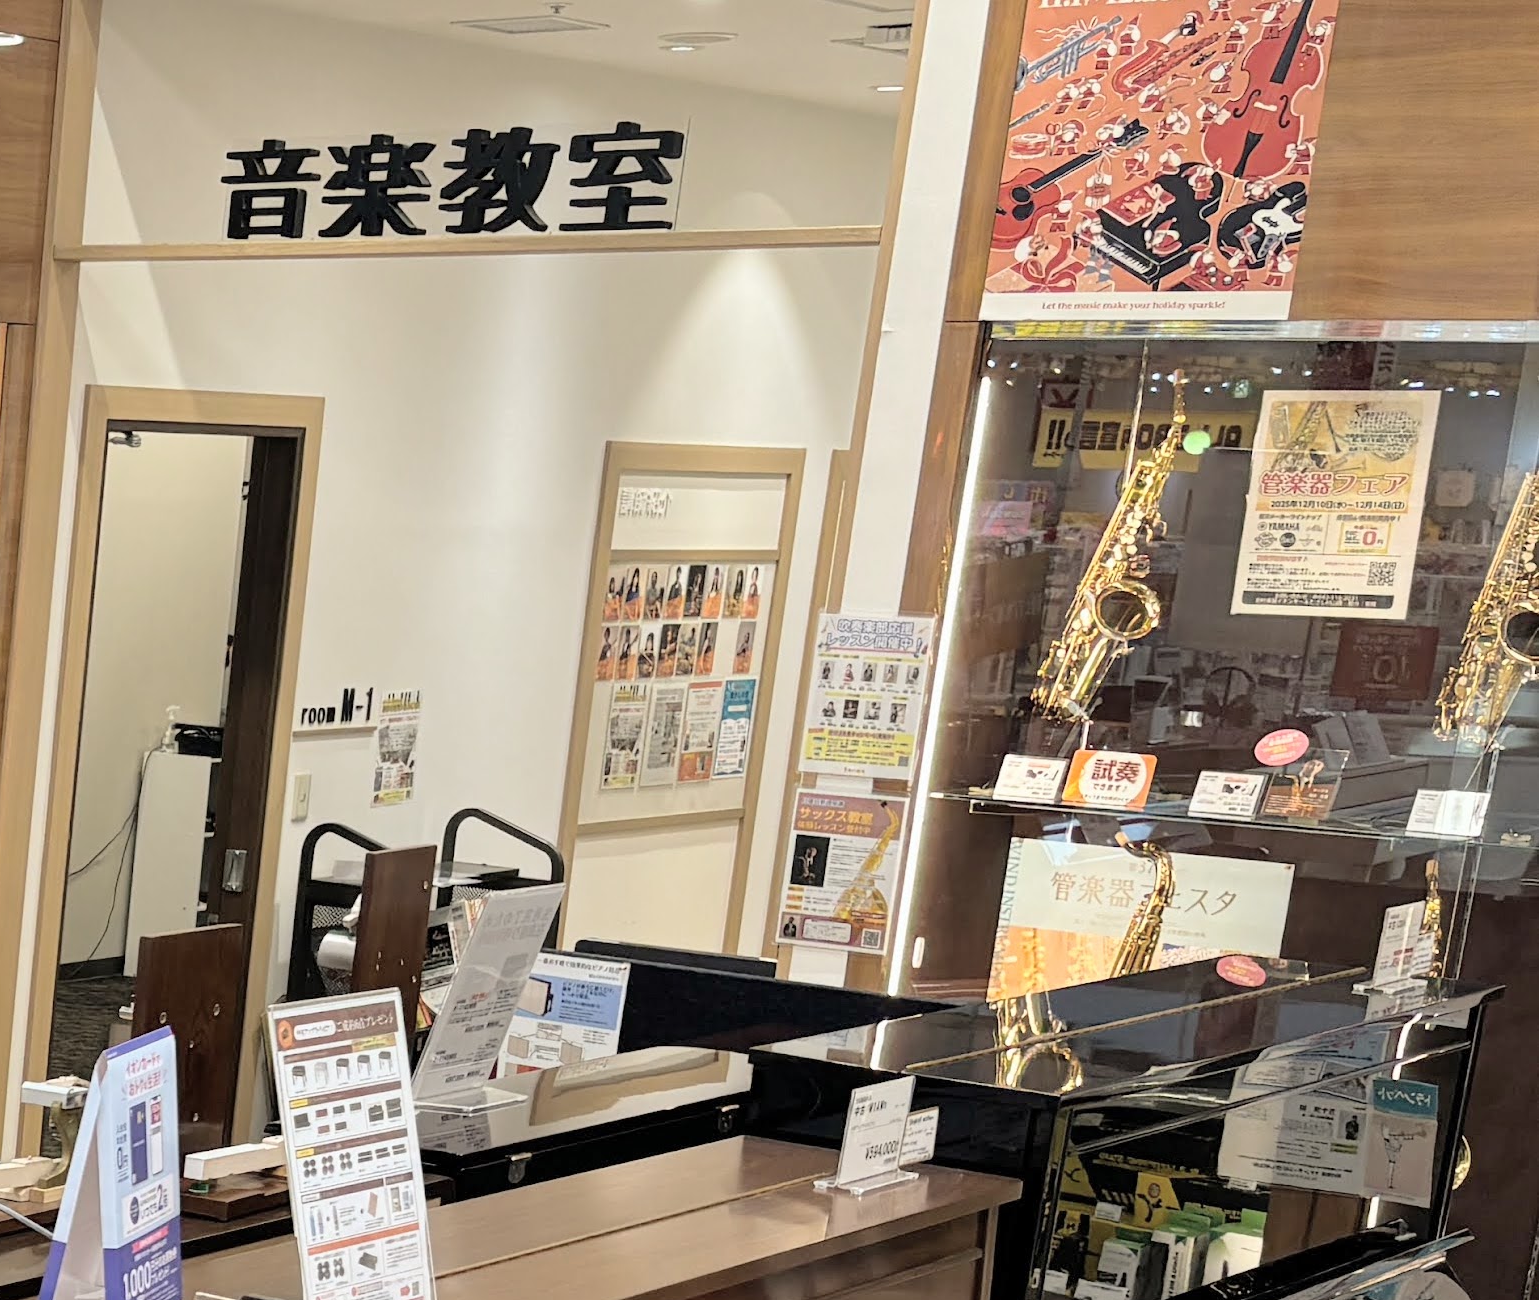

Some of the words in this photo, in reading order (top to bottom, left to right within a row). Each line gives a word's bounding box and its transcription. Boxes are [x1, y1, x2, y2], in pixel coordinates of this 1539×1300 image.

[221, 121, 685, 239] 音楽教室
[1260, 471, 1410, 497] 管楽器フェア
[301, 707, 336, 725] room
[341, 687, 374, 722] M-1
[1091, 758, 1141, 785] 試奏
